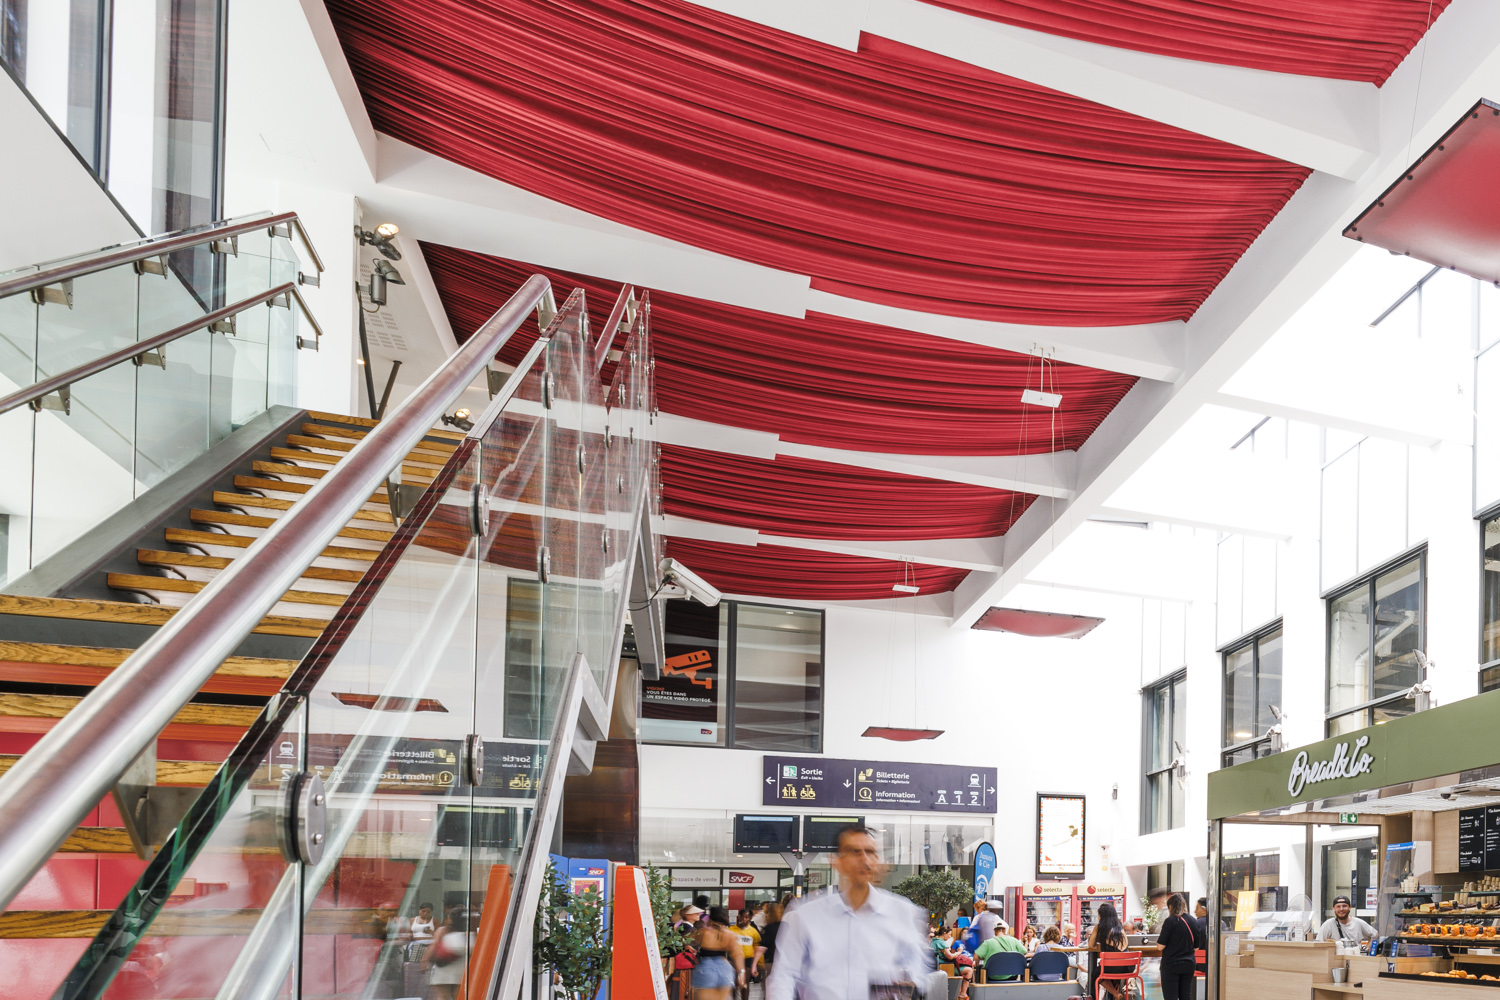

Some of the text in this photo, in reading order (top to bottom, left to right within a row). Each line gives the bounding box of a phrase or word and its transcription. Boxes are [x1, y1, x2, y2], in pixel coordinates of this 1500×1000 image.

[801, 767, 823, 776] Sortie
[876, 771, 910, 779] Billetterie
[875, 790, 916, 799] Information
[937, 794, 947, 803] A
[955, 794, 961, 804] 1
[970, 795, 978, 804] 2
[730, 875, 753, 883] SNCF
[1043, 885, 1063, 893] selecta
